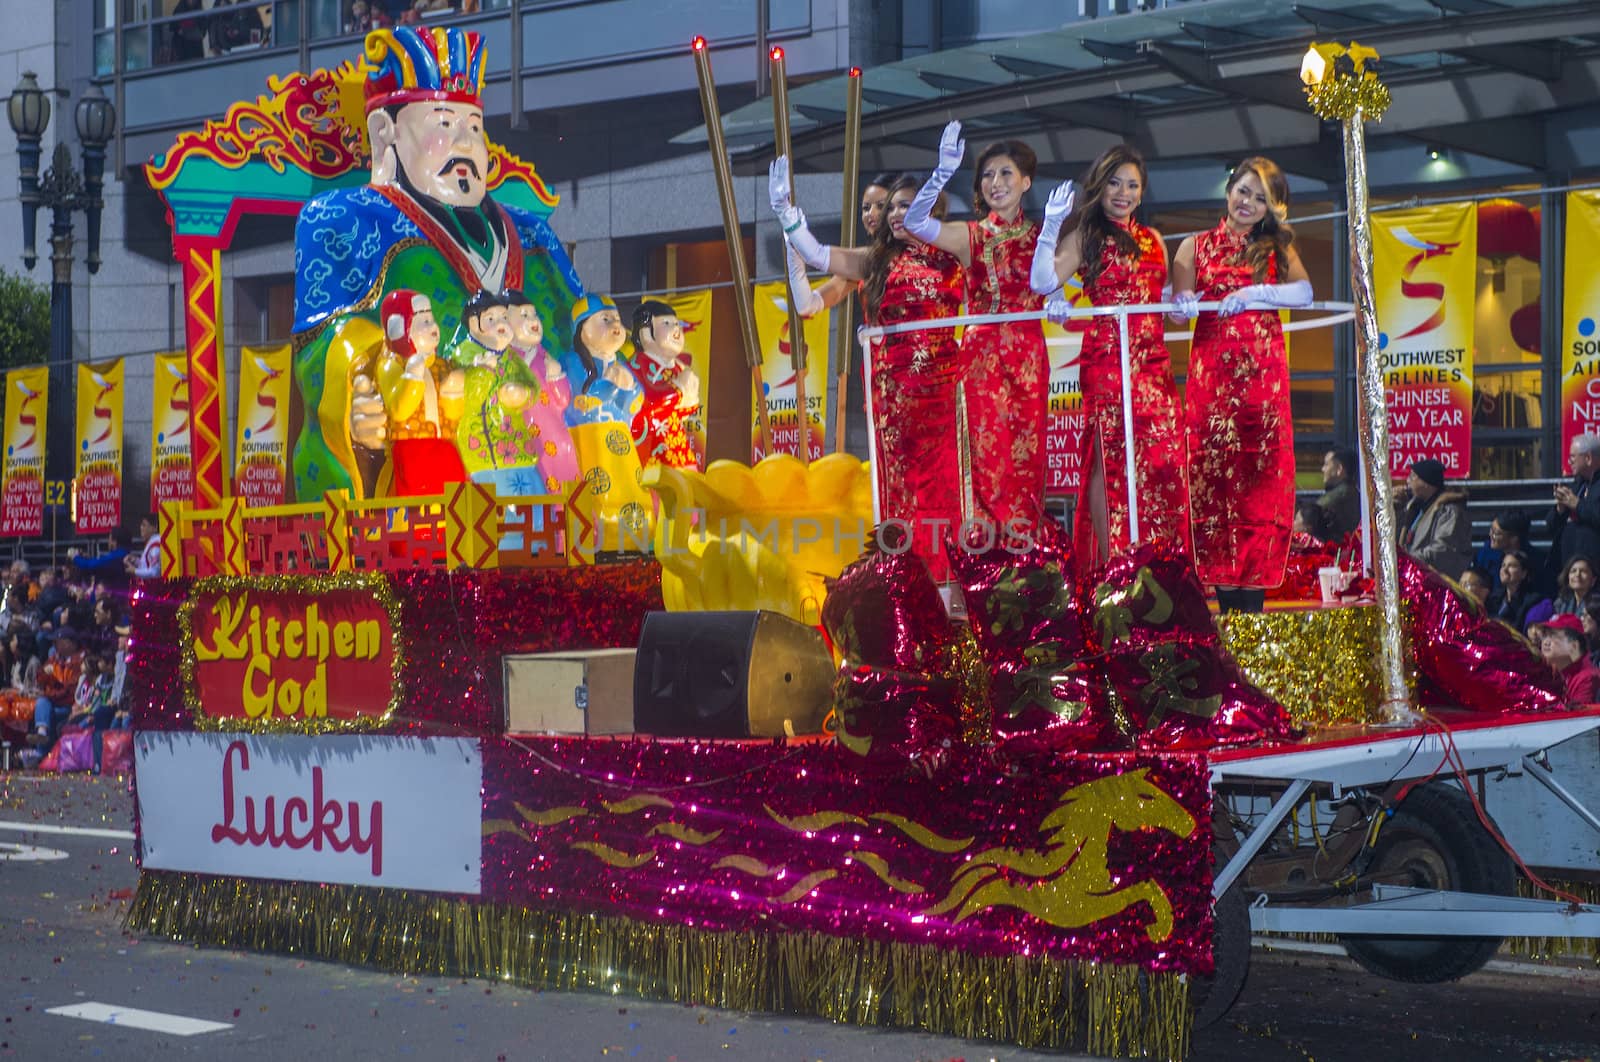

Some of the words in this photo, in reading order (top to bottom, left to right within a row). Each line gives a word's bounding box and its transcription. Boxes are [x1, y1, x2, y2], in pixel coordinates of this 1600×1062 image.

[1379, 348, 1465, 369] OUTHWEST
[1383, 368, 1462, 386] IRLINES
[755, 412, 820, 425] ARLINS
[1047, 414, 1085, 431] CHINE
[1387, 411, 1409, 428] EW
[1417, 408, 1464, 427] YEAR
[770, 428, 813, 444] HINEE
[1046, 434, 1067, 450] EW
[1388, 431, 1452, 449] ESTIVAL
[155, 444, 190, 456] SOUTHWE
[241, 441, 283, 453] SOUTHWEST
[155, 457, 190, 469] AIRLINE
[1393, 451, 1459, 470] PARDE
[246, 466, 276, 480] CHINESE
[46, 481, 65, 505] E2
[154, 483, 173, 496] NEW
[240, 480, 260, 495] NEW
[263, 481, 282, 495] YEAR
[79, 490, 99, 502] NEW
[193, 590, 381, 662] Kitchen
[242, 652, 328, 719] God
[211, 740, 383, 877] Lucky
